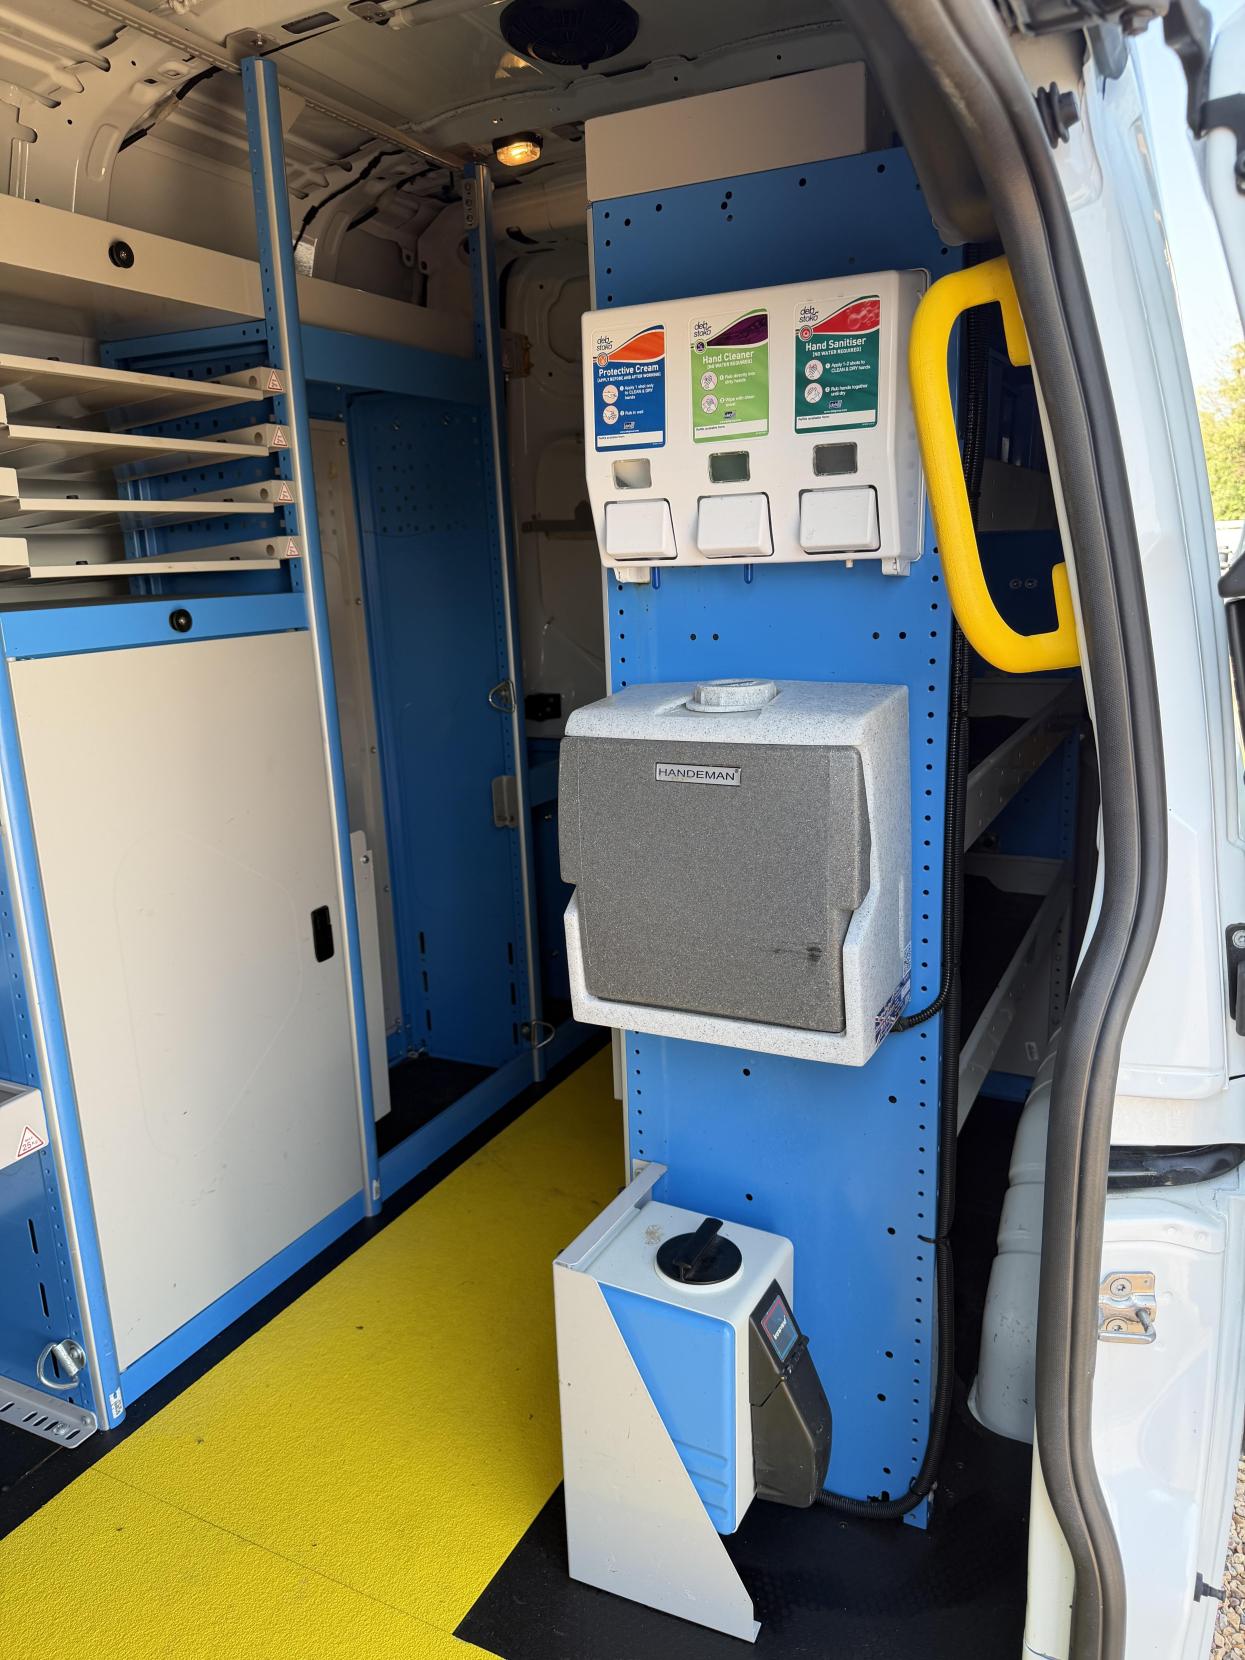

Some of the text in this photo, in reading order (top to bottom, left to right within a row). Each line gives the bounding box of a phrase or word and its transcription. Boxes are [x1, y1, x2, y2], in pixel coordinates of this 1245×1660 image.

[805, 337, 866, 351] Hand Sanitiser
[702, 350, 755, 364] Hand Cleaner
[598, 364, 659, 377] Protective Cream
